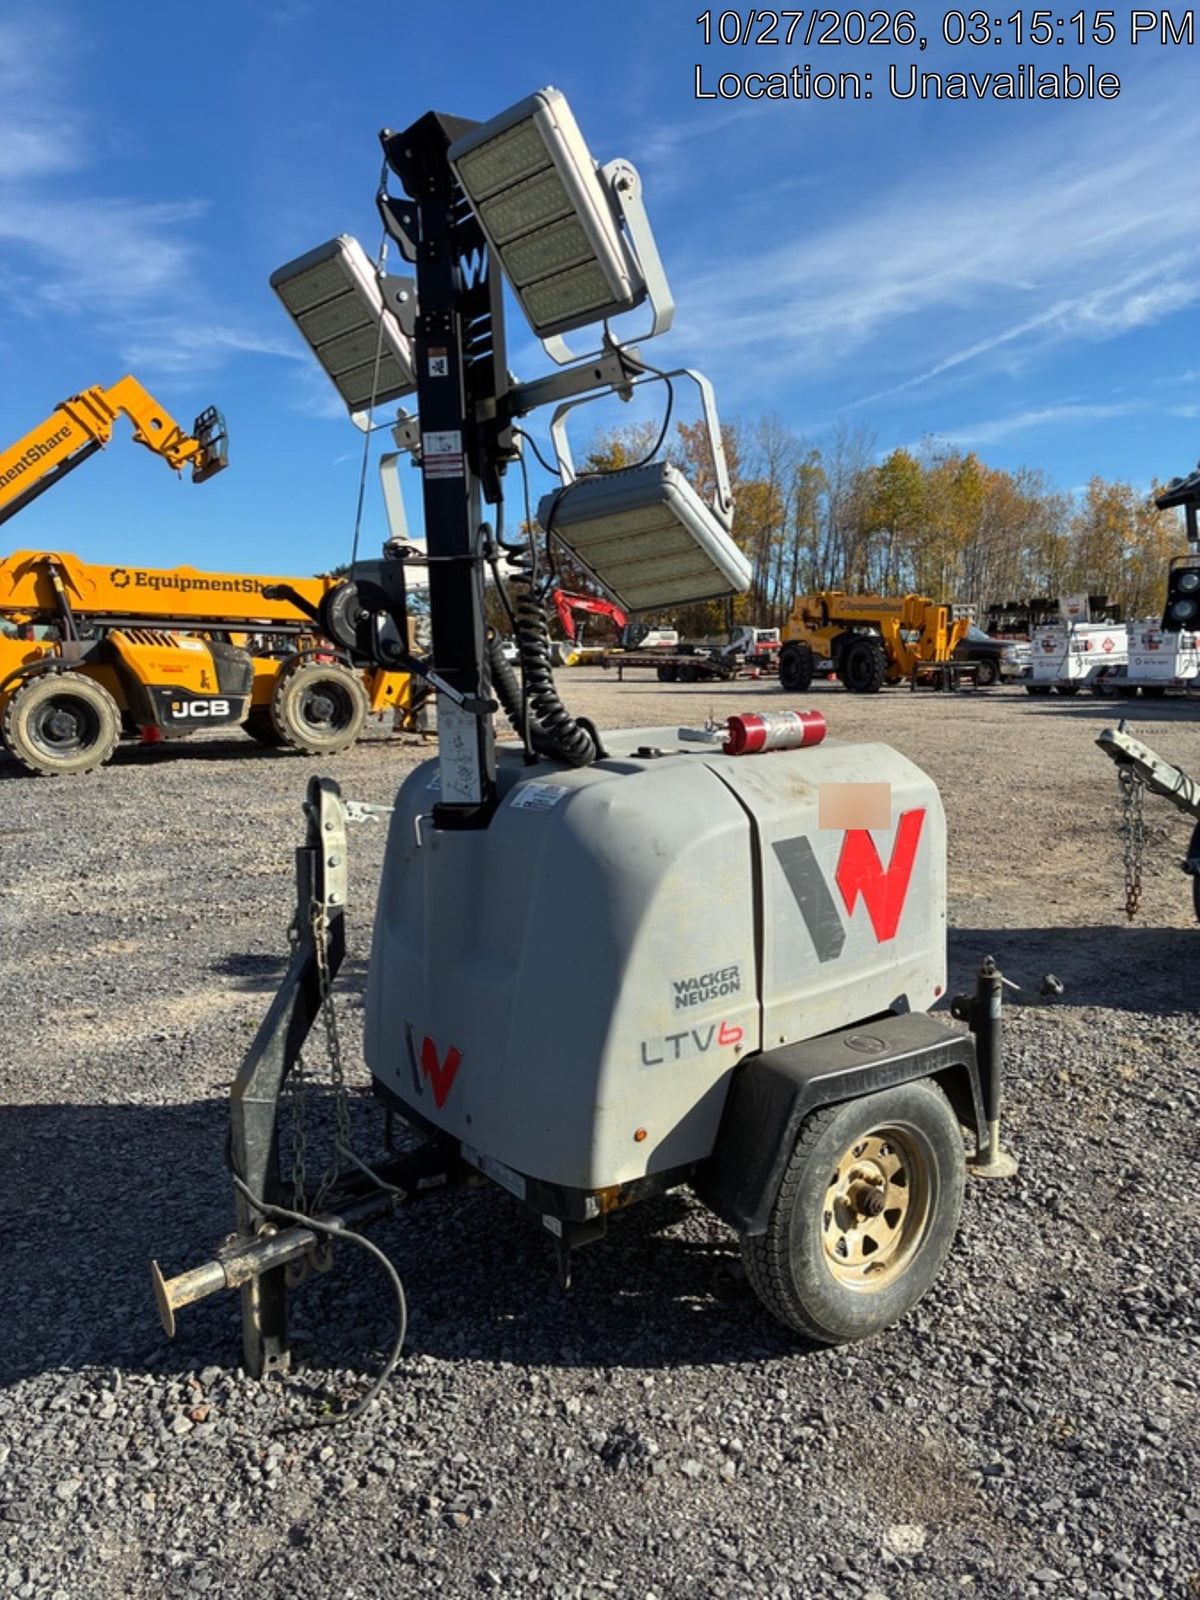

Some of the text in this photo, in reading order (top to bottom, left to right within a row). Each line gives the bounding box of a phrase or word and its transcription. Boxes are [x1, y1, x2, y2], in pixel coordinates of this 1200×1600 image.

[134, 571, 273, 594] EquipmentSh
[171, 700, 230, 718] JCB
[673, 965, 740, 994] WACKER
[675, 978, 741, 1009] NEUSON
[641, 1020, 744, 1066] LTV6
